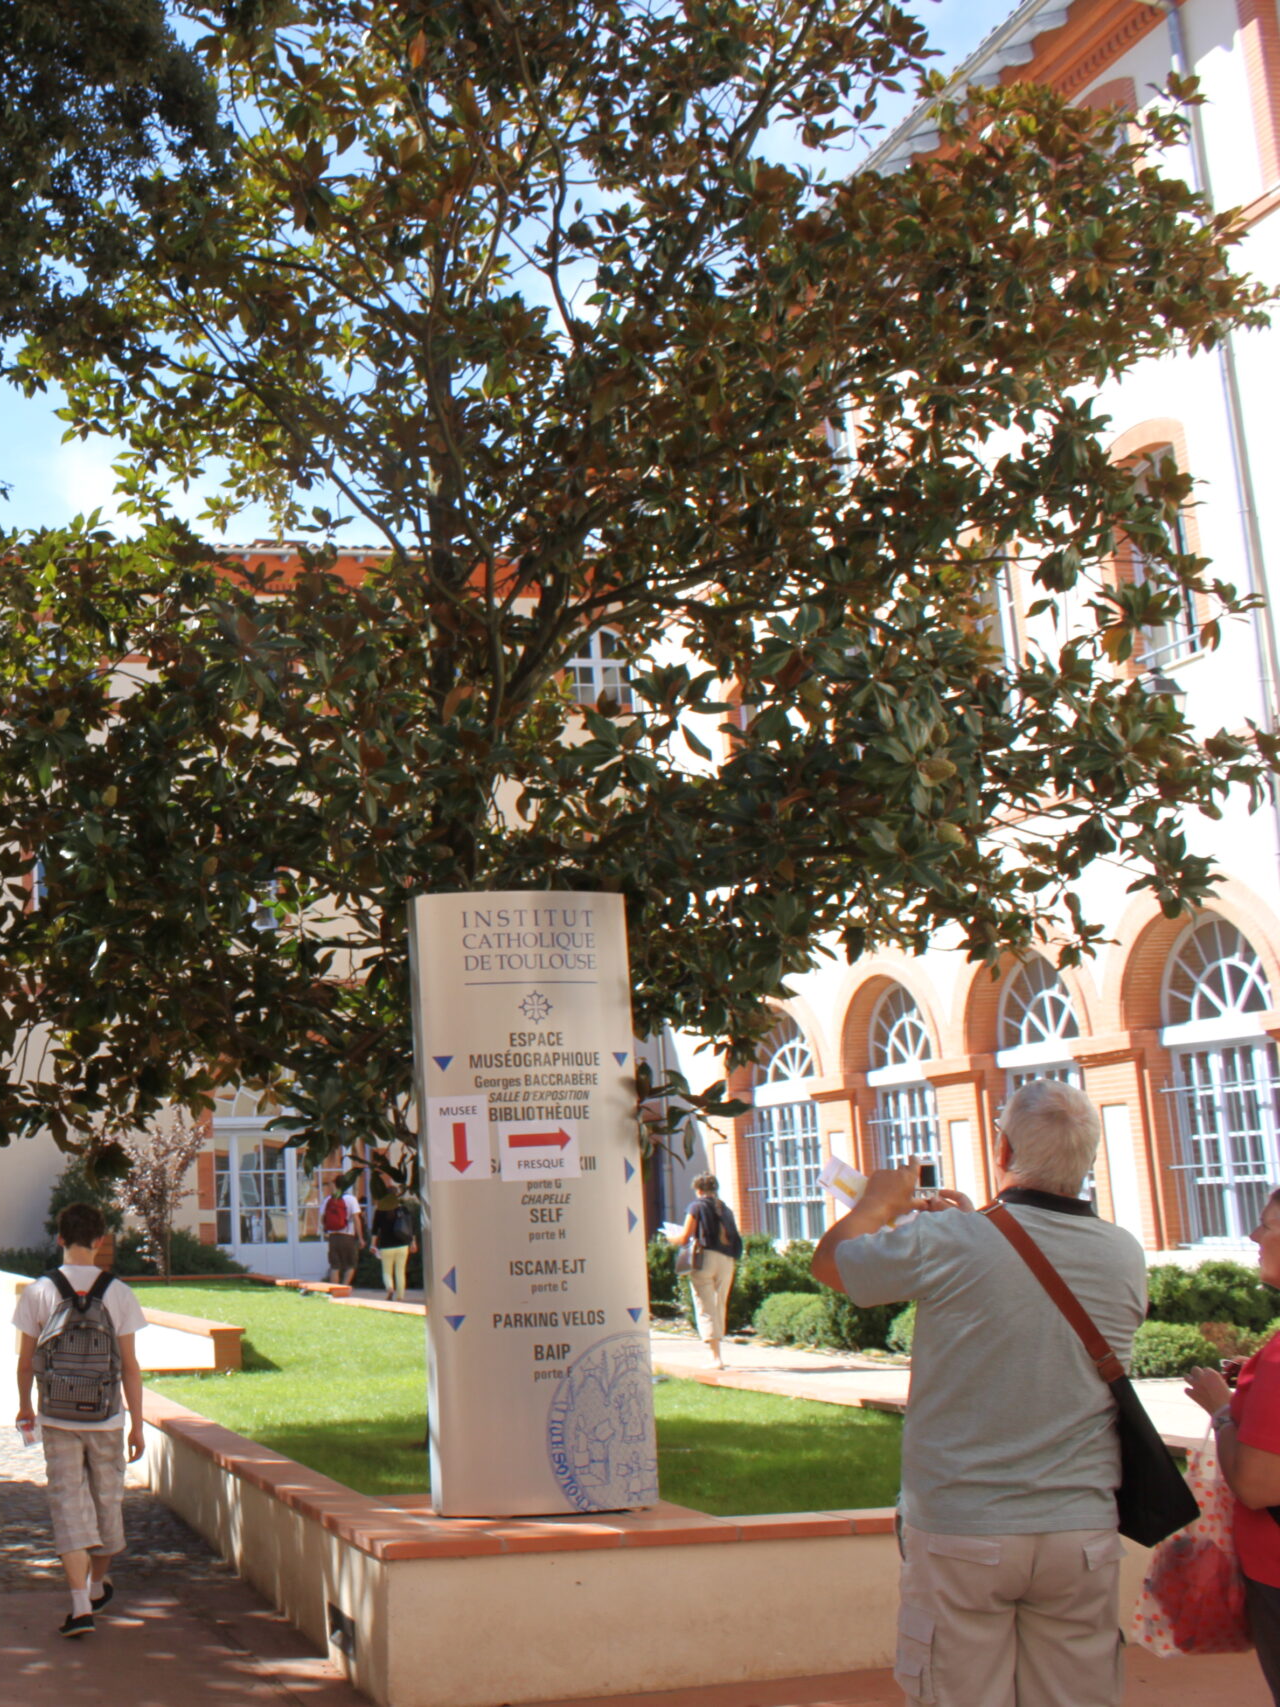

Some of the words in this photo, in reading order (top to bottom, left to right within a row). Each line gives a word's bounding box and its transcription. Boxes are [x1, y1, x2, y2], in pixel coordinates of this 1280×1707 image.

[461, 909, 594, 928] INSTITUT
[462, 932, 595, 951] CATHOLIQUE
[464, 955, 491, 971] DE
[497, 953, 596, 970] TOULOUSE
[509, 1032, 564, 1047] ESPACE
[469, 1050, 600, 1069] MUSÉOGRAPHIQUE
[474, 1075, 522, 1089] Georges
[524, 1070, 599, 1086] BACCRABÈRE
[488, 1091, 521, 1103] SALLE
[523, 1090, 590, 1102] D'EXPOSITION
[439, 1105, 478, 1117] MUSEE
[488, 1103, 590, 1122] BIBLIOTHÈQUE
[517, 1158, 565, 1170] FRESQUE
[527, 1180, 553, 1191] porte
[521, 1193, 572, 1205] CHAPELLE
[529, 1208, 563, 1224] SELF
[528, 1231, 556, 1243] porte
[558, 1229, 566, 1240] H
[509, 1259, 586, 1276] ISCAM-EJT
[531, 1282, 559, 1294] porte
[561, 1281, 568, 1291] C
[493, 1312, 559, 1329] PARKING
[562, 1310, 605, 1326] VELOS
[534, 1343, 571, 1360] BAIP
[534, 1369, 563, 1383] porte
